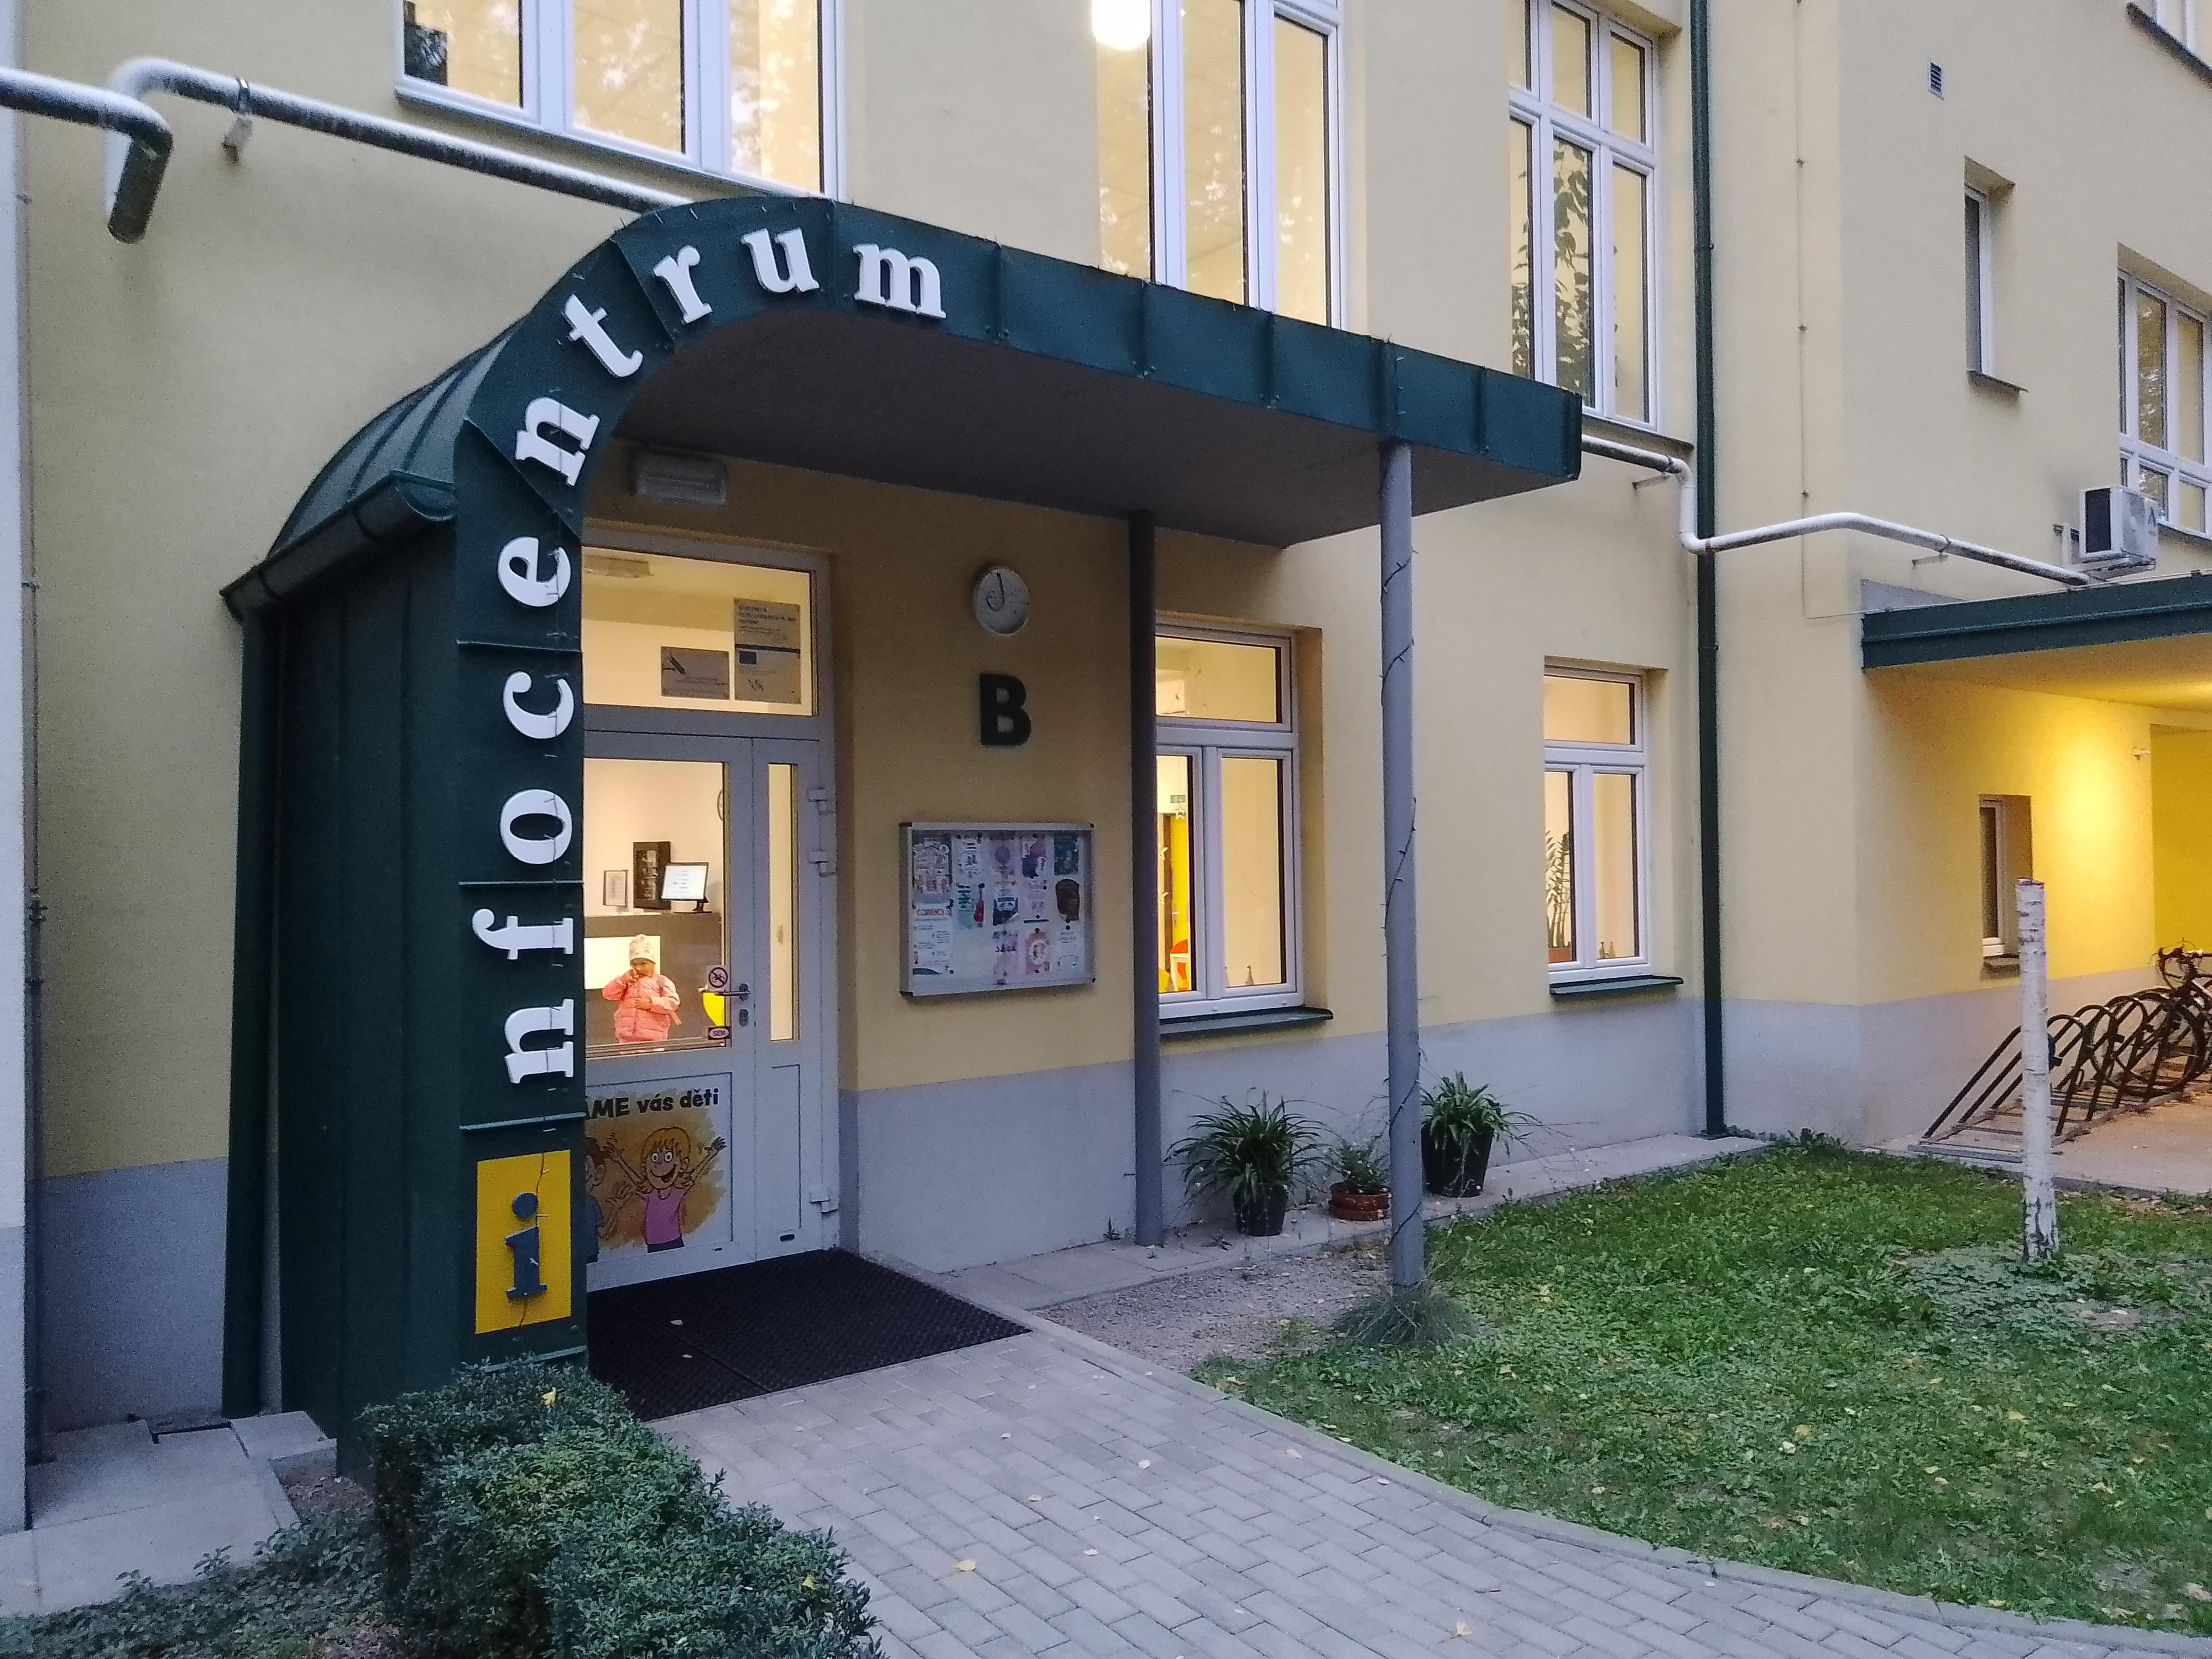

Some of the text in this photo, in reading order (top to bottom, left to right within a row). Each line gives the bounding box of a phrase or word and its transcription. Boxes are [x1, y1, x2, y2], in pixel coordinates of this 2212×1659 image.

[980, 674, 1032, 745] B
[637, 1093, 675, 1114] vás
[679, 1088, 719, 1109] děti
